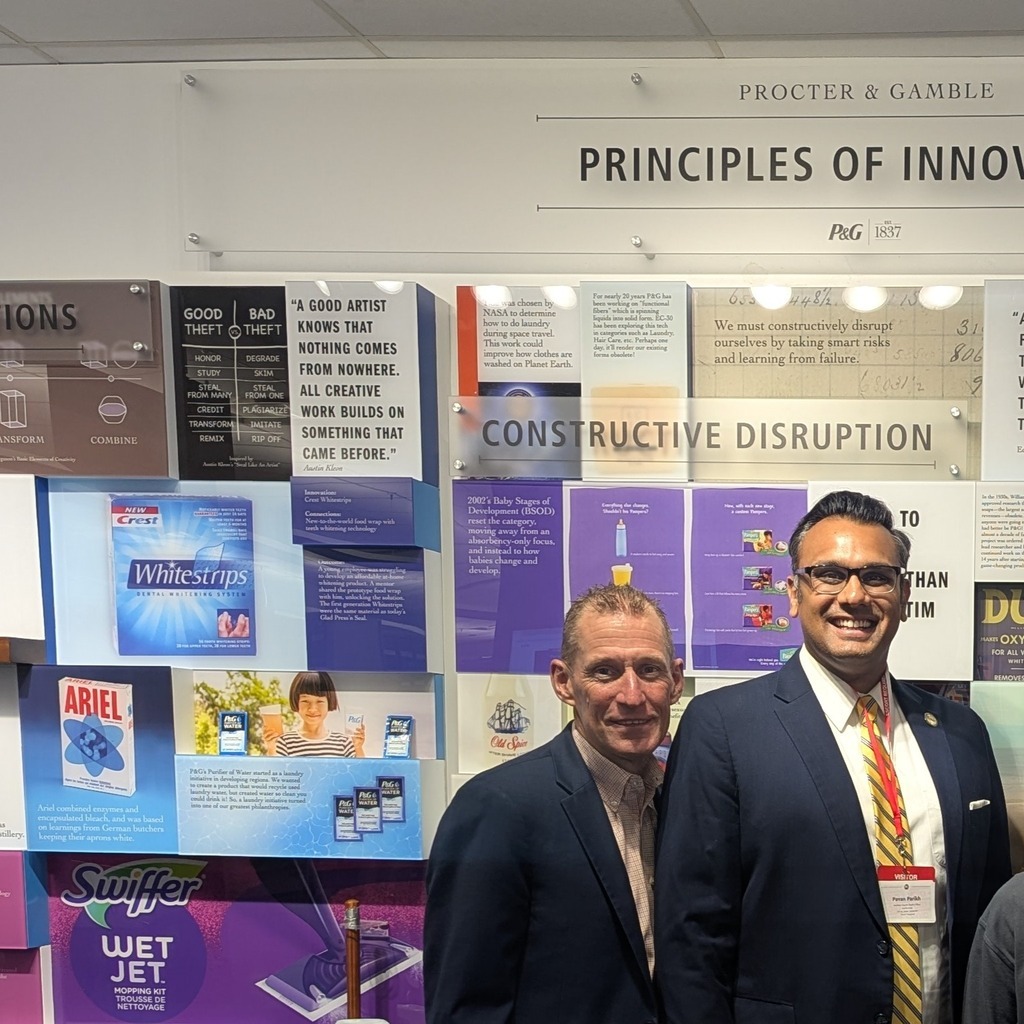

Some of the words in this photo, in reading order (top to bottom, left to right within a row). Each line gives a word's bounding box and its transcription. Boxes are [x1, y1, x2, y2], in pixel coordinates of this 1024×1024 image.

[740, 84, 854, 100] PROCTER
[865, 84, 878, 100] &
[890, 83, 994, 99] GAMBLE
[581, 147, 812, 182] PRINCIPLES
[833, 146, 883, 181] OF
[828, 224, 863, 240] P&G
[875, 226, 901, 239] 1837
[292, 300, 304, 311] "A
[309, 299, 342, 312] GOOD
[347, 300, 386, 312] ARTIST
[0, 304, 77, 330] IONS
[183, 307, 223, 320] GOOD
[249, 308, 275, 320] BAD
[184, 323, 223, 335] THEFT
[243, 324, 282, 335] THEFT
[298, 321, 340, 333] KNOWS
[344, 321, 373, 333] THAT
[714, 319, 733, 331] We
[737, 321, 765, 331] must
[768, 319, 848, 333] constructively
[852, 319, 893, 333] disrupt
[299, 342, 350, 354] NOTHING
[356, 342, 397, 354] COMES
[197, 369, 221, 377] STUDY
[300, 363, 332, 375] FROM
[338, 364, 399, 376] NOWHERE.
[300, 384, 320, 396] ALL
[326, 385, 381, 397] CREATIVE
[242, 406, 288, 414] PLAGIARIZE
[301, 406, 335, 418] WORK
[341, 406, 383, 418] BUILDS
[389, 406, 404, 418] ON
[189, 420, 234, 428] TRANSFORM
[302, 426, 370, 439] SOMETHING
[375, 427, 404, 439] THAT
[482, 420, 721, 449] CONSTRUCTIVE
[737, 422, 932, 451] DISRUPTION
[91, 436, 138, 444] COMBINE
[251, 435, 265, 443] RIP
[267, 435, 282, 443] OFF
[303, 448, 336, 459] CAME
[341, 448, 396, 460] BEFORE."
[467, 496, 491, 505] 2002's
[493, 497, 513, 506] Baby
[515, 497, 540, 507] Stages
[542, 497, 551, 505] of
[117, 515, 159, 525] Crest
[900, 510, 920, 527] TO
[134, 563, 248, 590] Whitestrips
[64, 685, 122, 721] ARIEL
[37, 804, 55, 812] Ariel
[56, 804, 91, 813] combined
[93, 806, 123, 814] enzymes
[125, 805, 139, 813] and
[61, 863, 202, 917] Swiffer
[101, 935, 173, 959] WET
[110, 961, 165, 984] JET
[114, 987, 152, 995] MOPPING
[116, 995, 152, 1003] TROUSSE
[117, 1003, 165, 1011] NETTOYAGE
